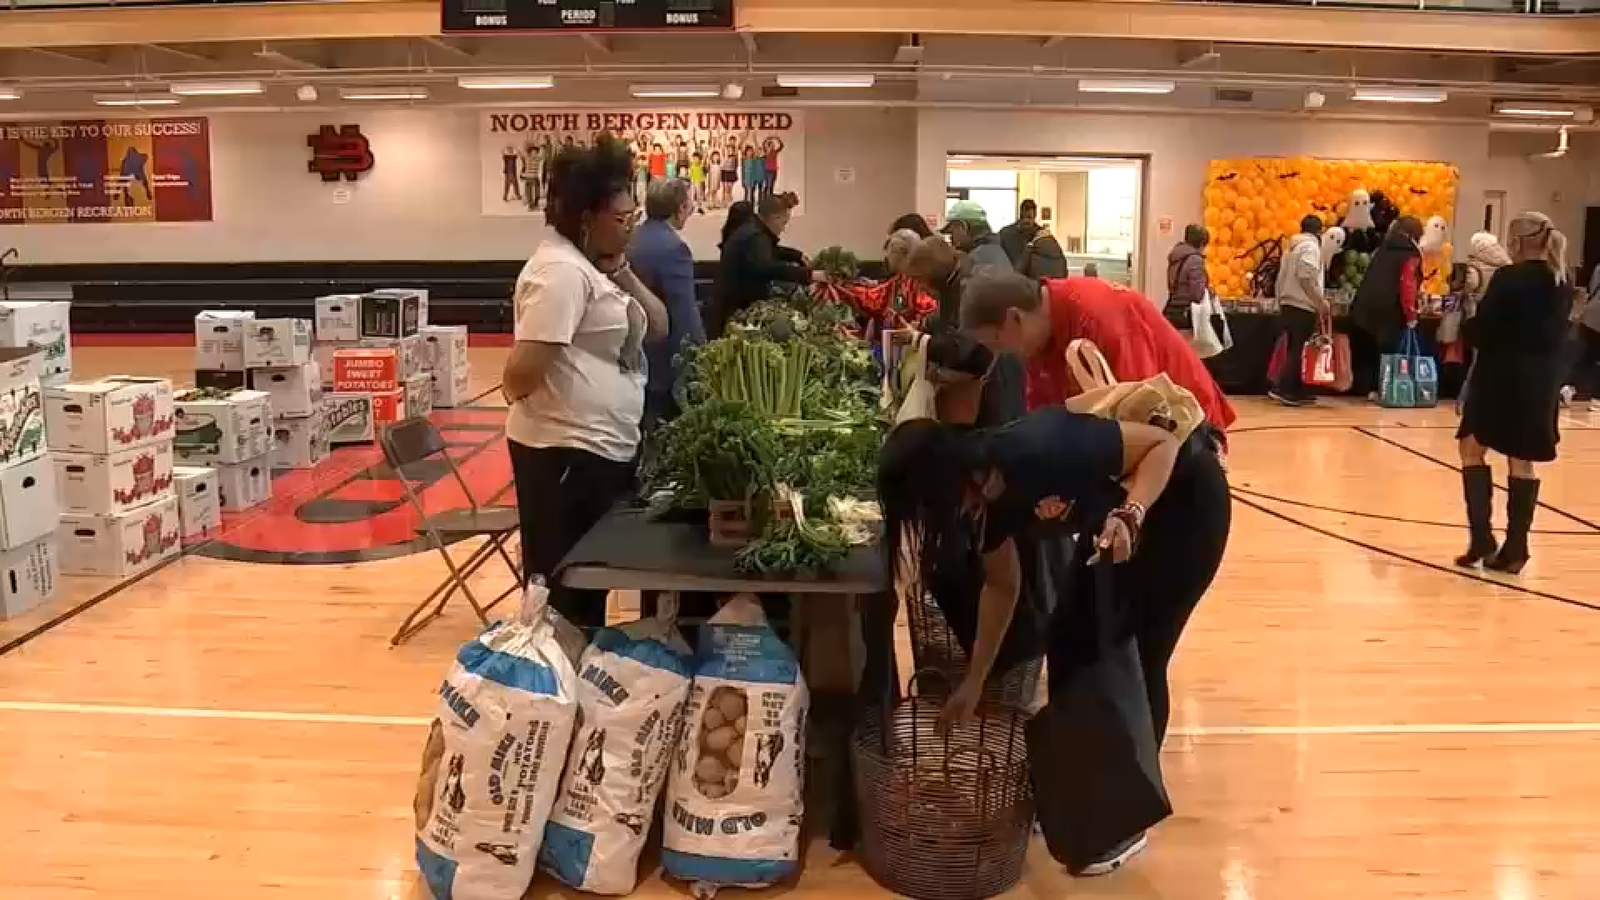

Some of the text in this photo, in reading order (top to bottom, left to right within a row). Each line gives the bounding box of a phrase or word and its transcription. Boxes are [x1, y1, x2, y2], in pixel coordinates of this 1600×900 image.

[561, 9, 596, 20] PERIOD
[666, 13, 699, 24] BONUS
[475, 15, 507, 26] BONUS
[490, 112, 793, 132] NORTH BERGEN UNITED
[6, 127, 19, 138] IS
[20, 126, 48, 138] THE
[51, 126, 78, 137] KEY
[80, 125, 99, 137] TO
[101, 124, 132, 136] OUR
[135, 122, 200, 136] SUCCESS!
[28, 207, 76, 218] BERGEN
[77, 206, 153, 218] RECREATION
[343, 359, 384, 368] JUMBO
[346, 369, 383, 379] SWEET
[338, 380, 394, 389] POTATOES
[487, 773, 504, 805] OLD
[721, 811, 768, 835] OLD
